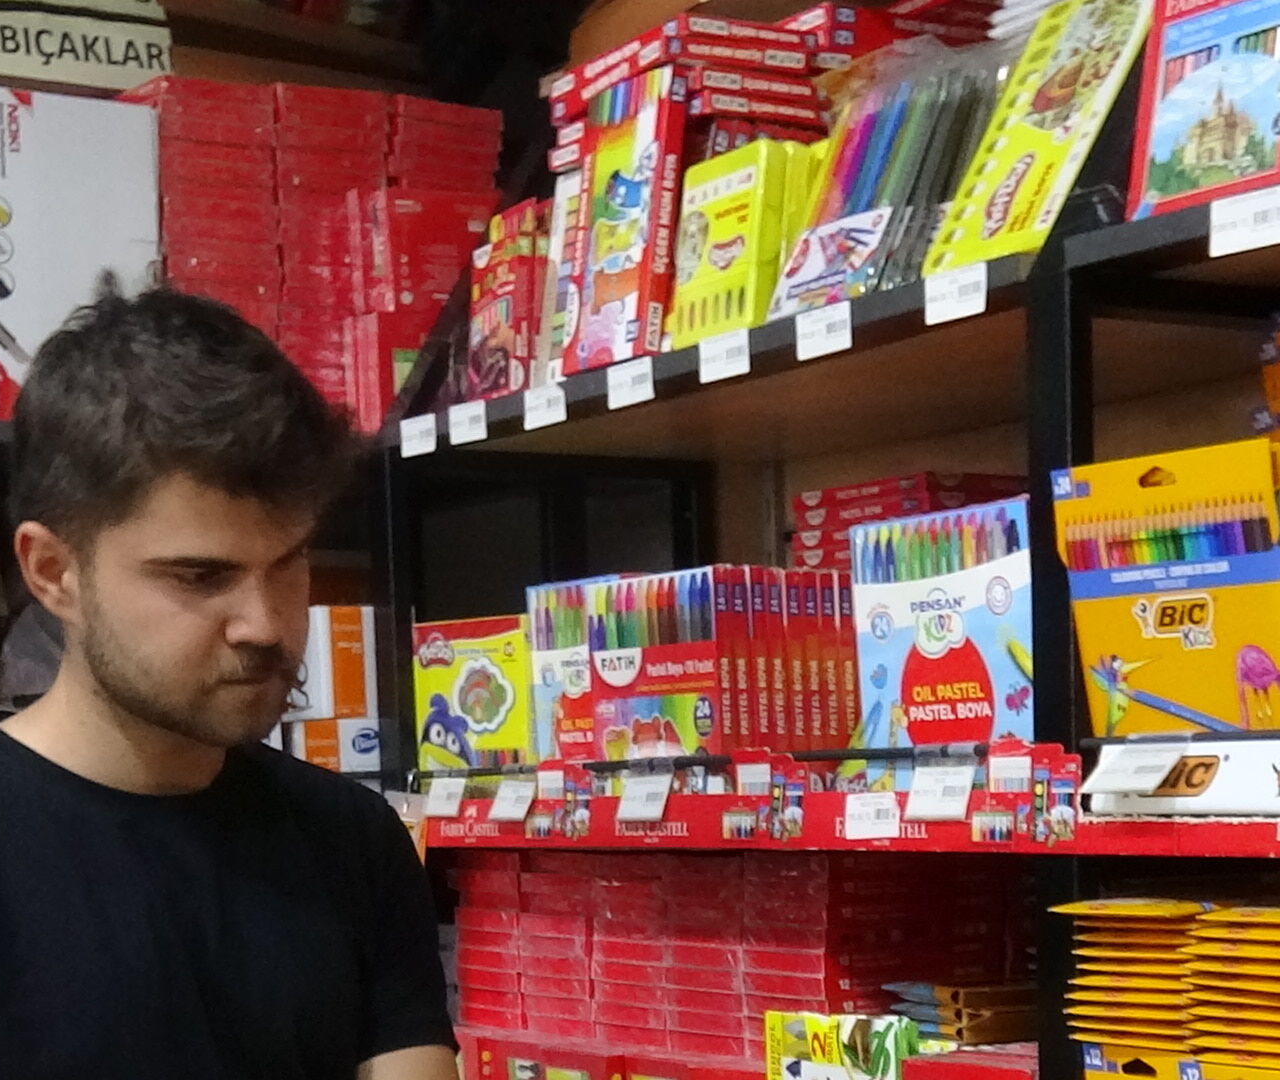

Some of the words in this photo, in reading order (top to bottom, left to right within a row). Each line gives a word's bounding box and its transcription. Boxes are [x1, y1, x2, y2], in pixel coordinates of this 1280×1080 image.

[7, 101, 22, 154] NOKI
[910, 600, 962, 614] PENSAN
[911, 686, 935, 702] OIL
[936, 682, 985, 700] PASTEL
[696, 700, 711, 718] 24
[908, 704, 955, 723] PASTEL
[957, 701, 993, 719] BOYA
[440, 819, 500, 838] FABER-CASTELL
[811, 1031, 828, 1057] 2
